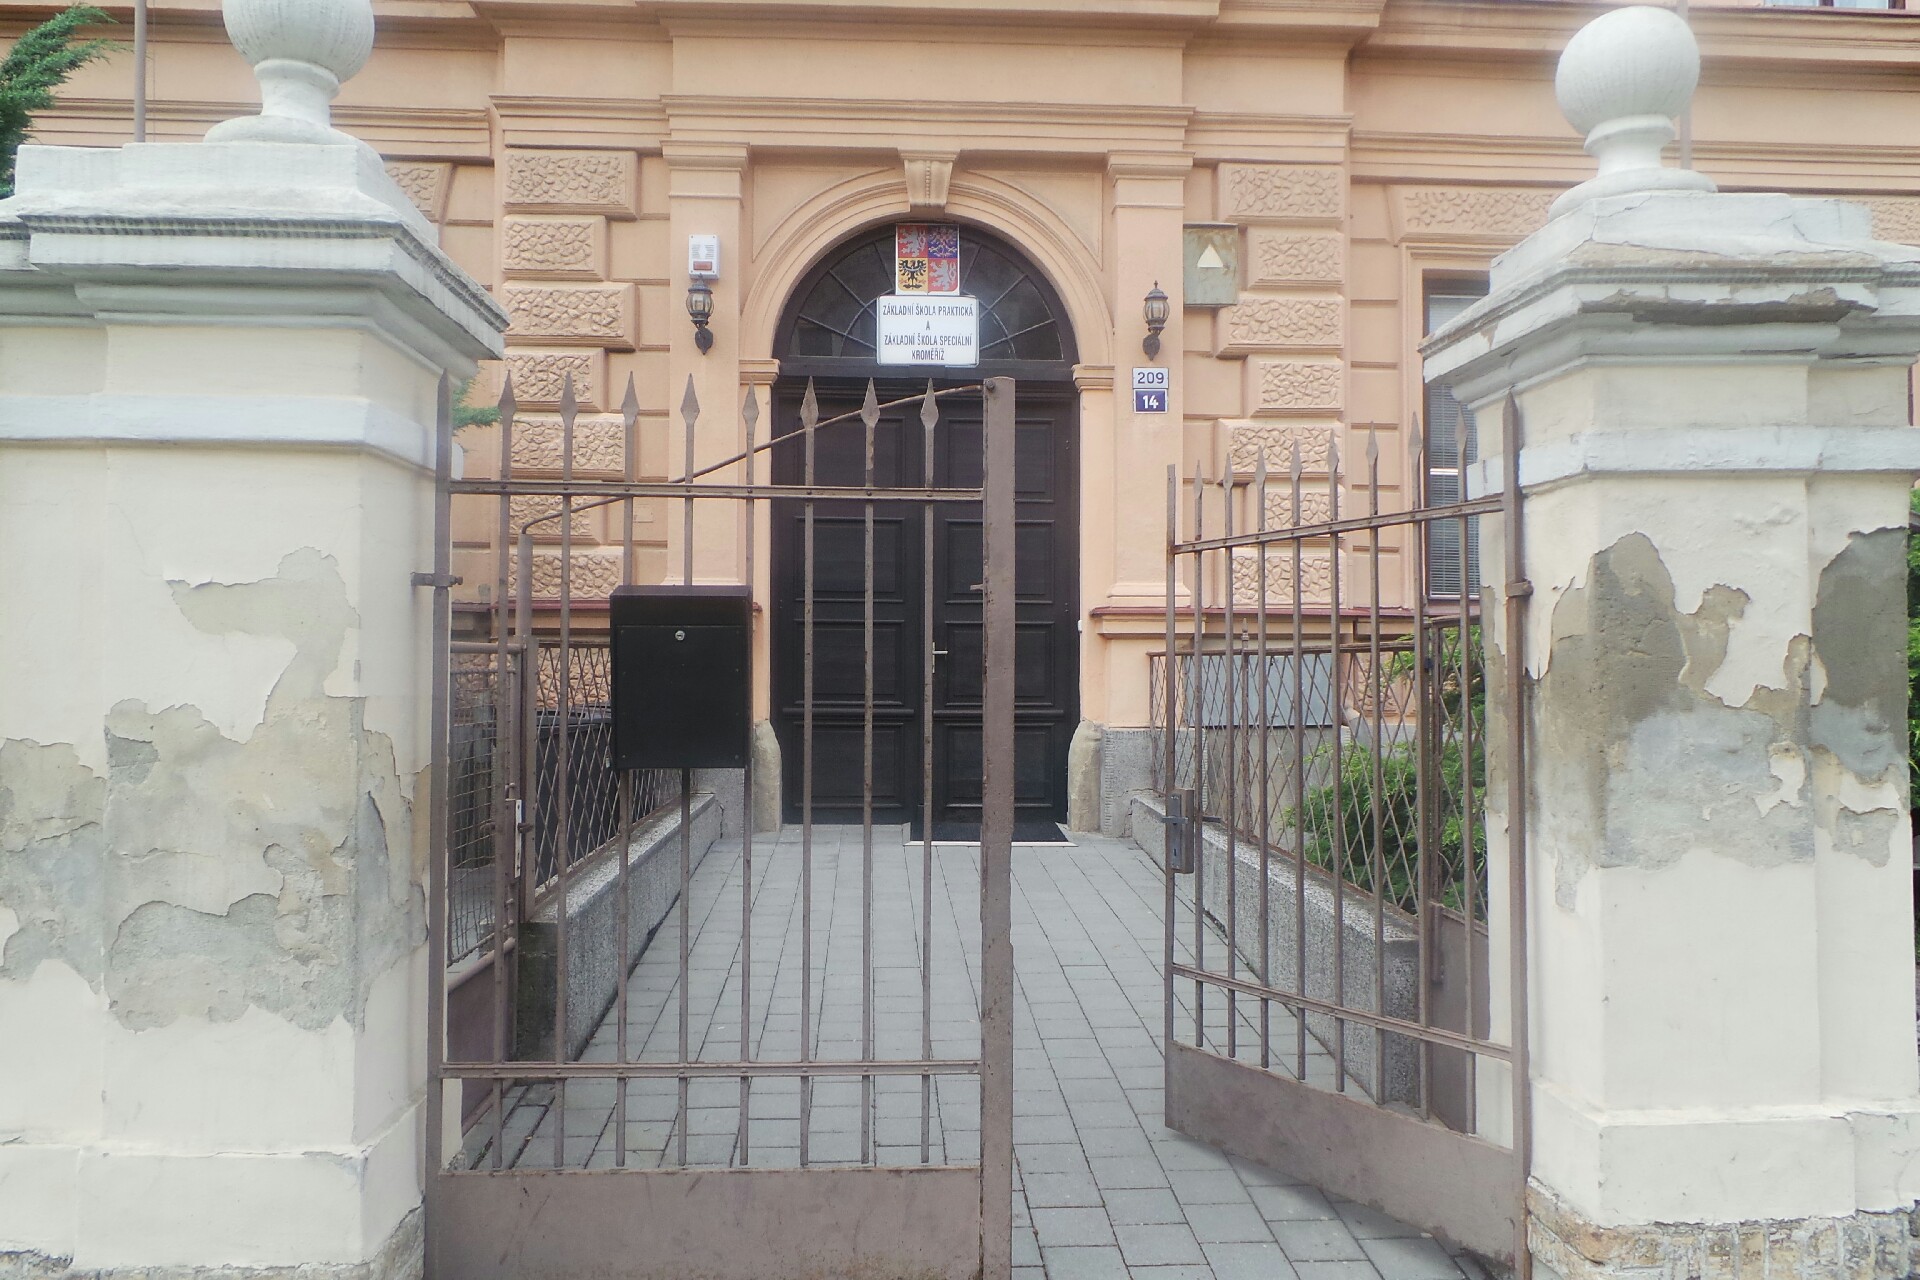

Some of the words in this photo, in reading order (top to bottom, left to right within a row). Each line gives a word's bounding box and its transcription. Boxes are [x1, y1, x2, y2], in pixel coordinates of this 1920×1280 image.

[882, 303, 914, 316] ZÁKLADNÍ
[915, 303, 936, 316] ŠKOLA
[938, 303, 974, 317] PRAKTICKÁ
[925, 320, 931, 331] A
[884, 333, 915, 346] ZÁKLADNÍ
[917, 332, 938, 346] ŠKOLA
[939, 333, 972, 346] SPECIÁLNÍ
[911, 347, 945, 361] KROMĚŘÍŽ
[1137, 371, 1165, 385] 209
[1142, 394, 1159, 409] 14
